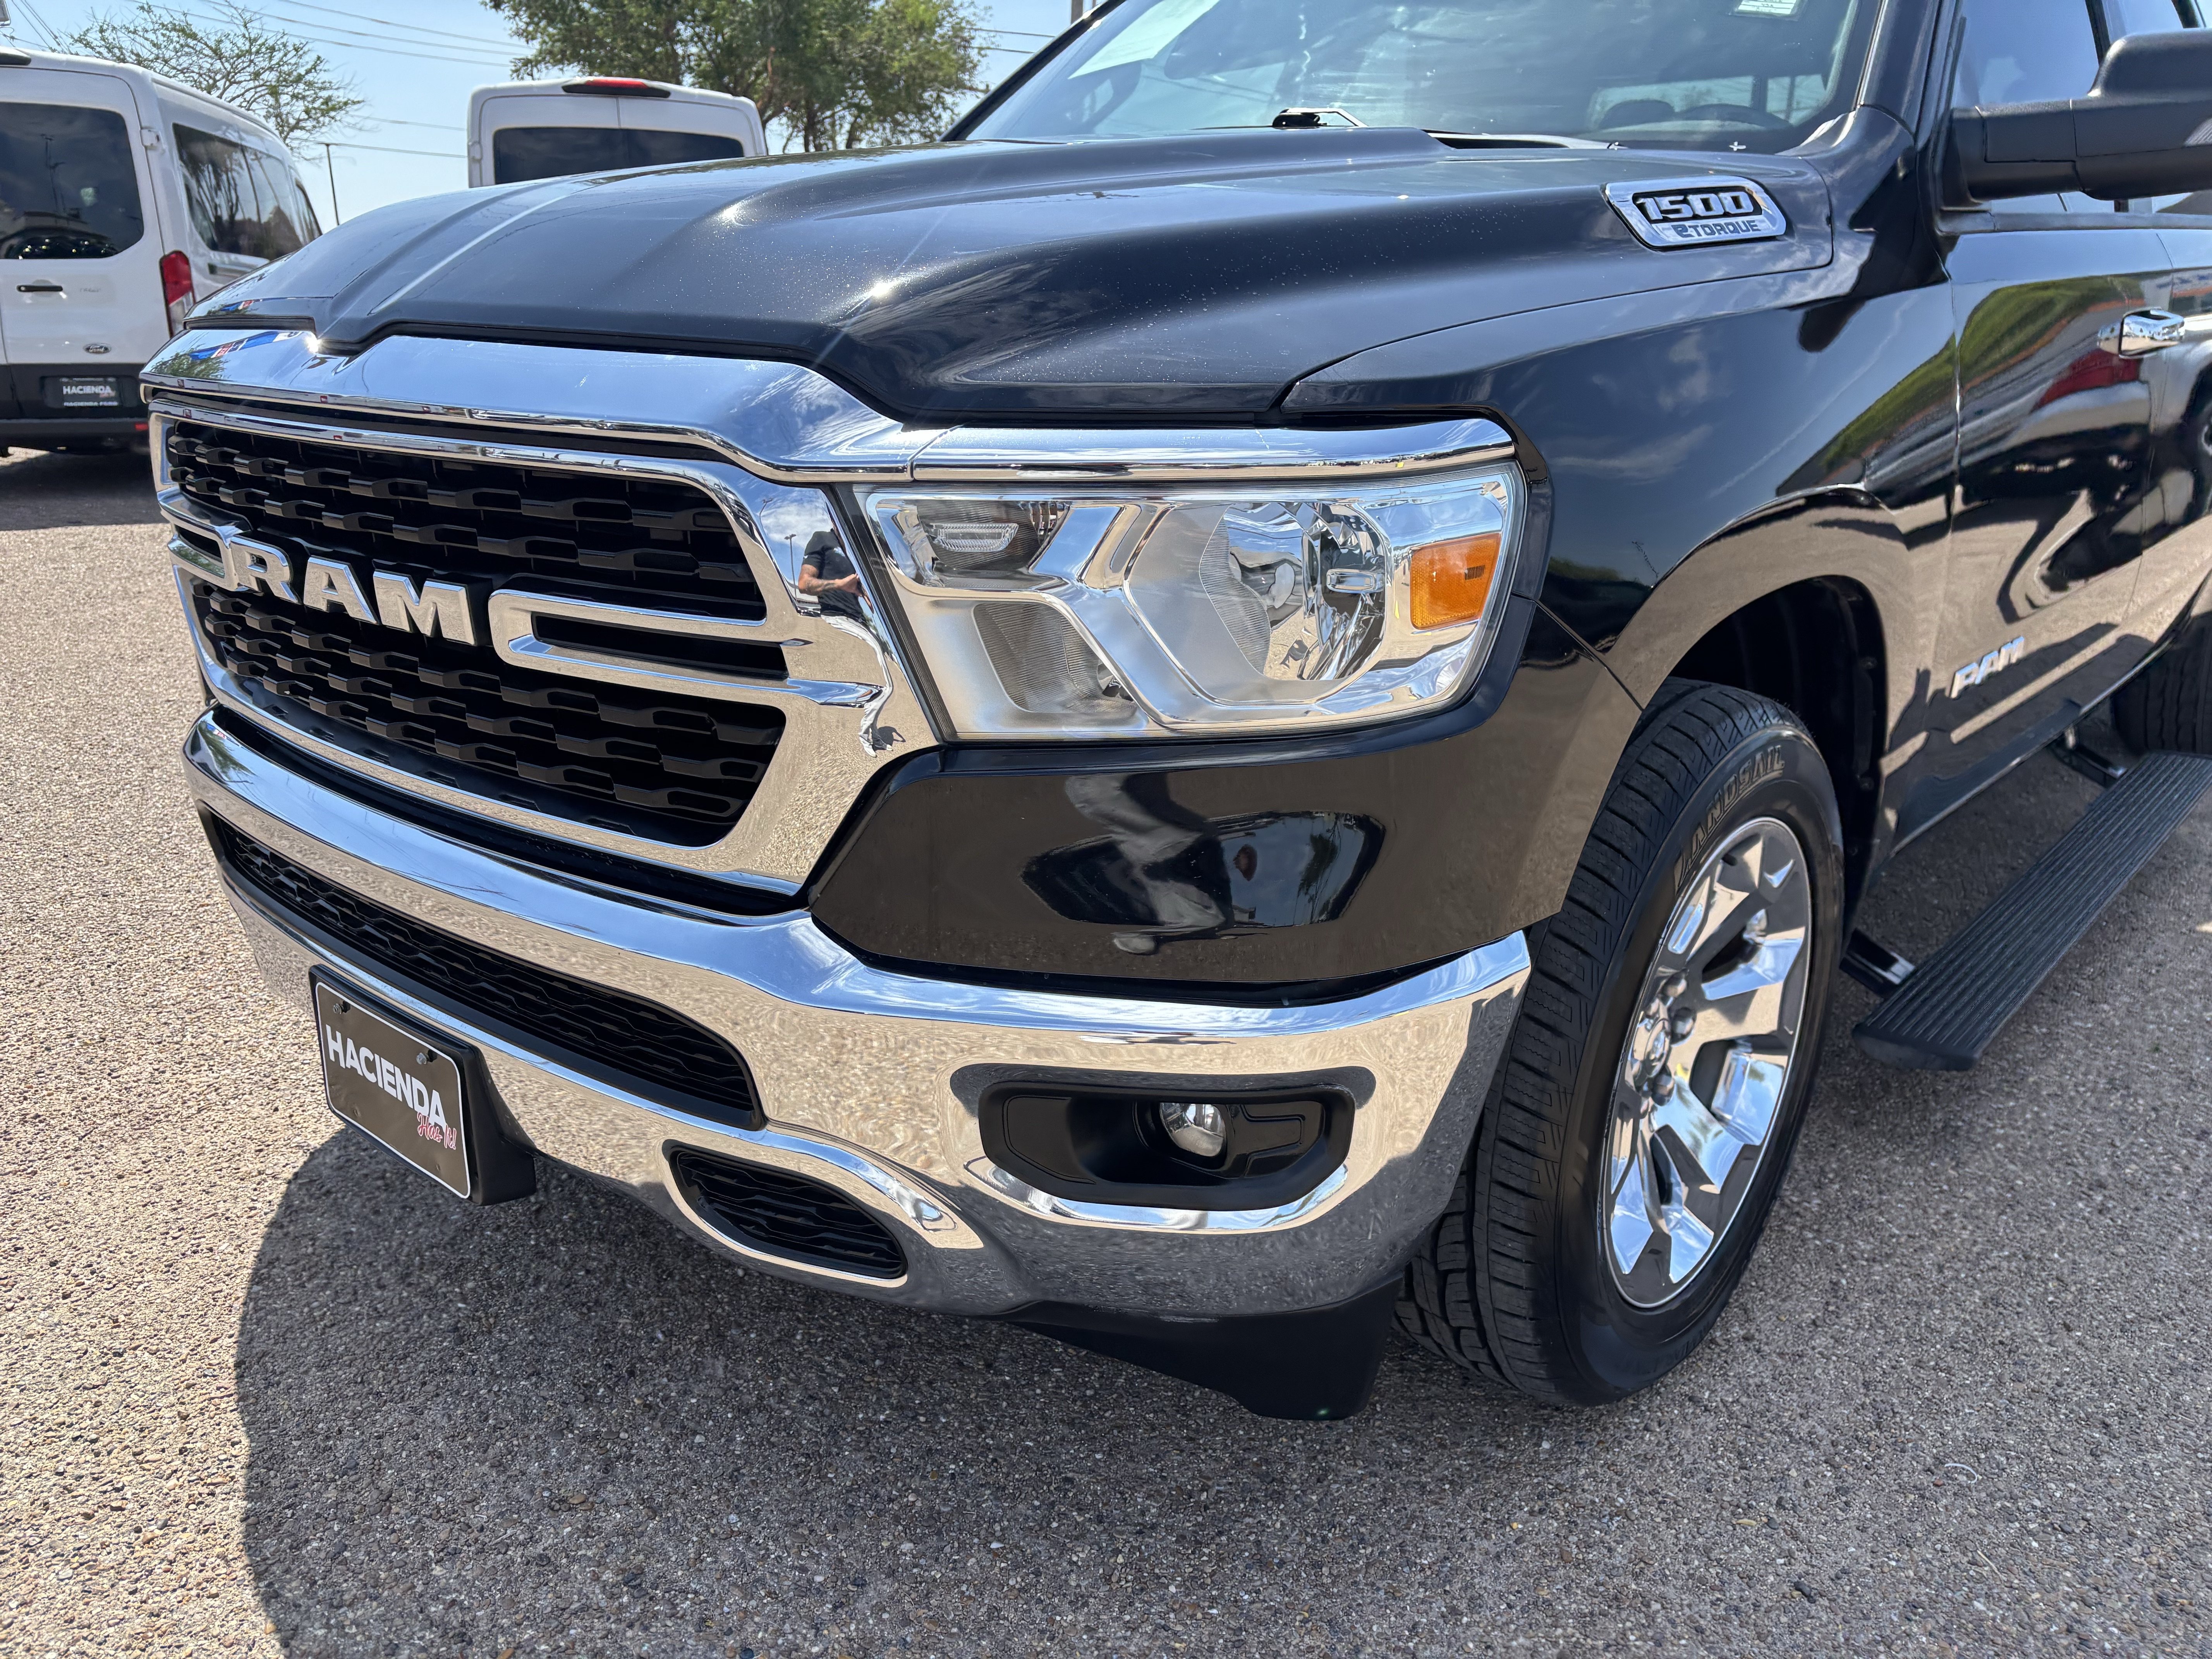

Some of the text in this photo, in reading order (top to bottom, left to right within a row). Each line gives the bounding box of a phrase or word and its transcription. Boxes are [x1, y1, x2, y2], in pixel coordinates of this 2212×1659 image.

[1637, 191, 1754, 220] 1500
[1672, 220, 1761, 237] eTORQUE
[63, 386, 112, 394] HACIENDA
[230, 535, 477, 646] RAM
[1951, 635, 2025, 699] RAM
[326, 1025, 447, 1131] HACIENDA
[417, 1112, 443, 1143] Has
